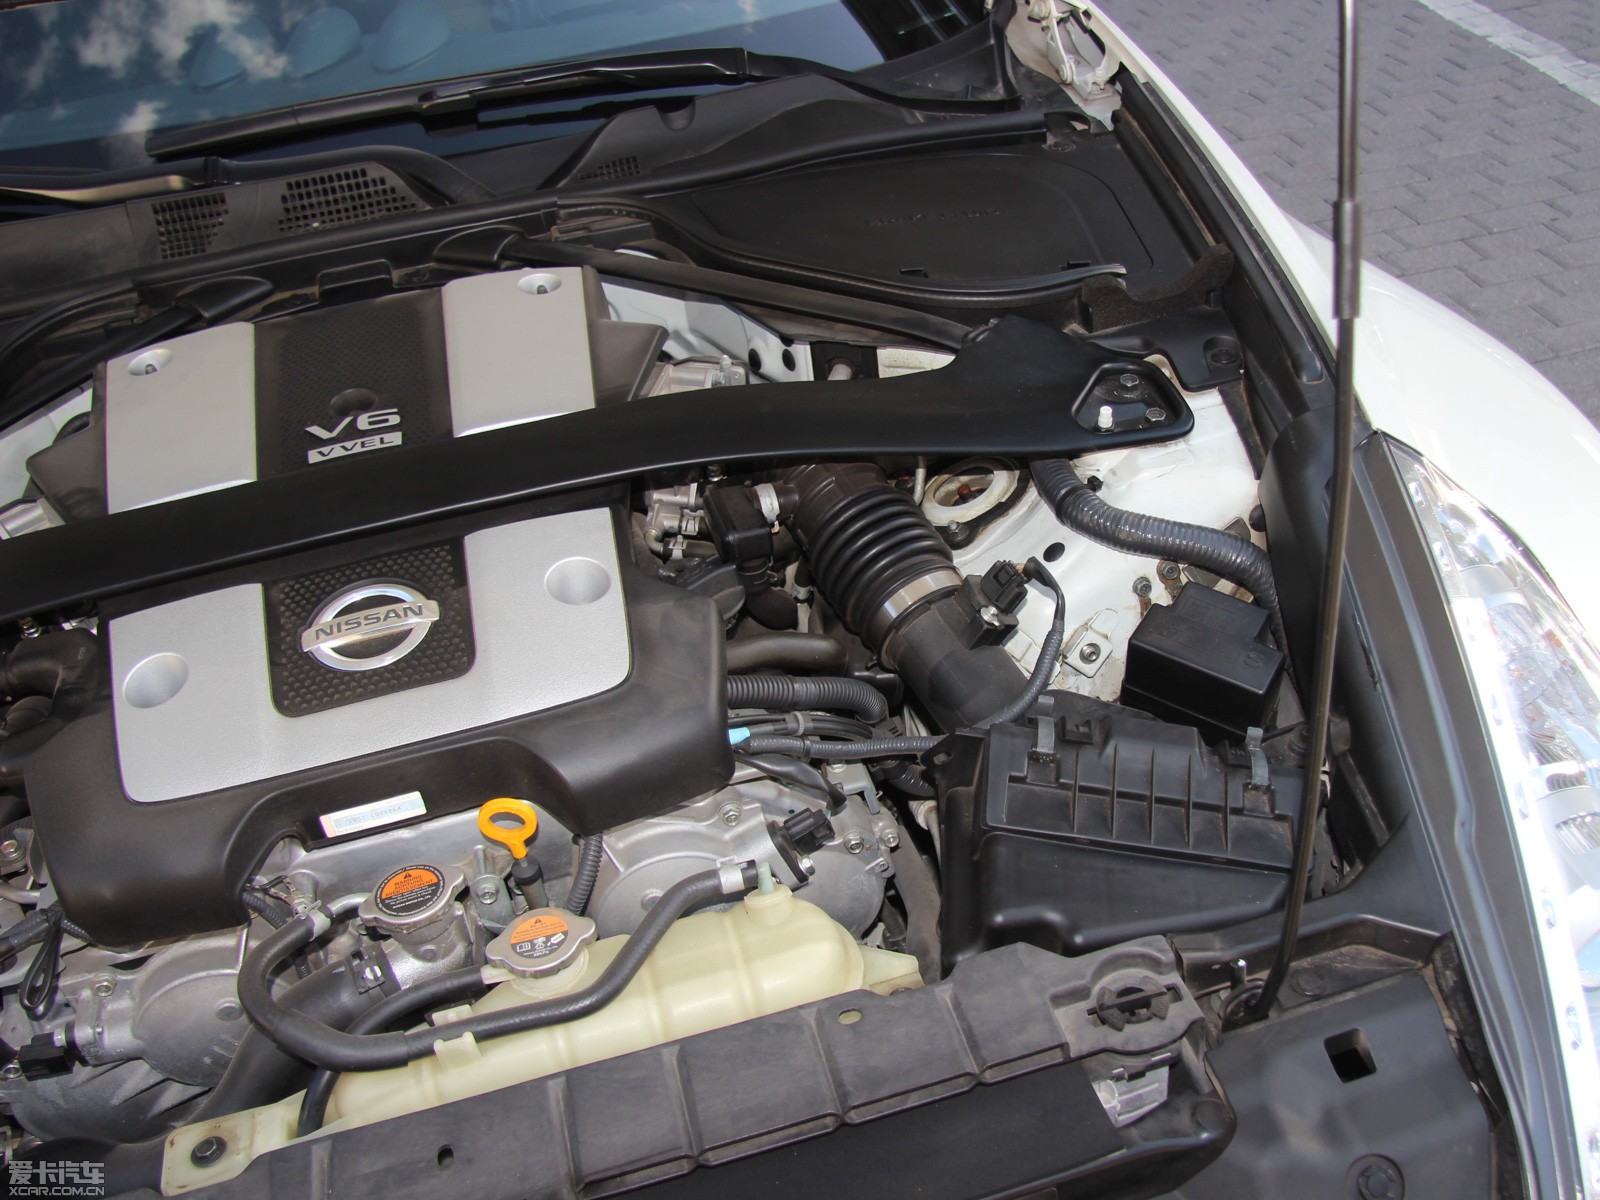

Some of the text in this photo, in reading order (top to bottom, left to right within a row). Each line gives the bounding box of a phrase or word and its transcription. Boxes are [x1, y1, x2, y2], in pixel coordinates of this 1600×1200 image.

[305, 408, 401, 440] V6
[316, 437, 394, 458] VVEL
[315, 603, 424, 640] NISSAN
[393, 875, 422, 885] WARNING
[394, 879, 423, 890] ACHTUNG
